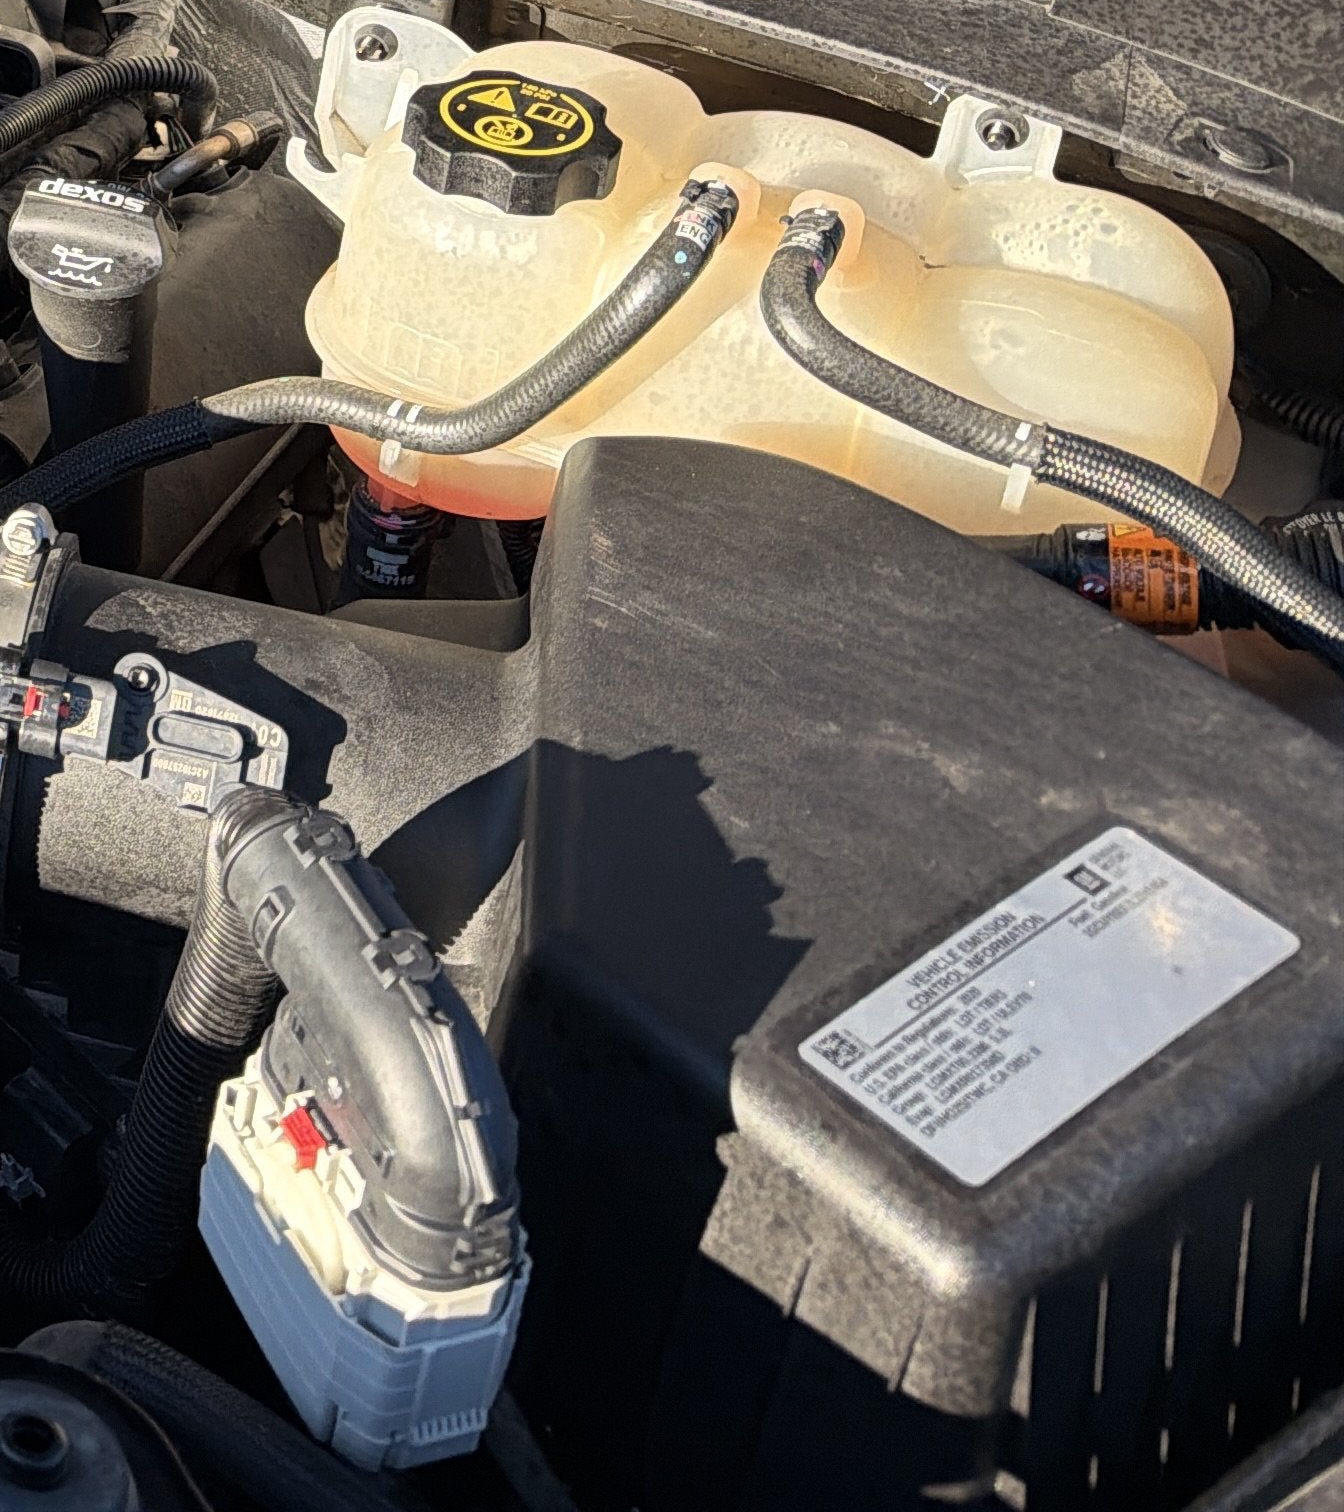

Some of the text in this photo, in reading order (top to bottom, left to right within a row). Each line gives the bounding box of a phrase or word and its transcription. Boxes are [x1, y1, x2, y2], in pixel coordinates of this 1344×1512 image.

[38, 178, 150, 213] dexos
[680, 224, 712, 245] ENG
[906, 911, 1016, 988] VEHICLE EMISSION
[907, 911, 1045, 1011] CONTROL INFORMATION
